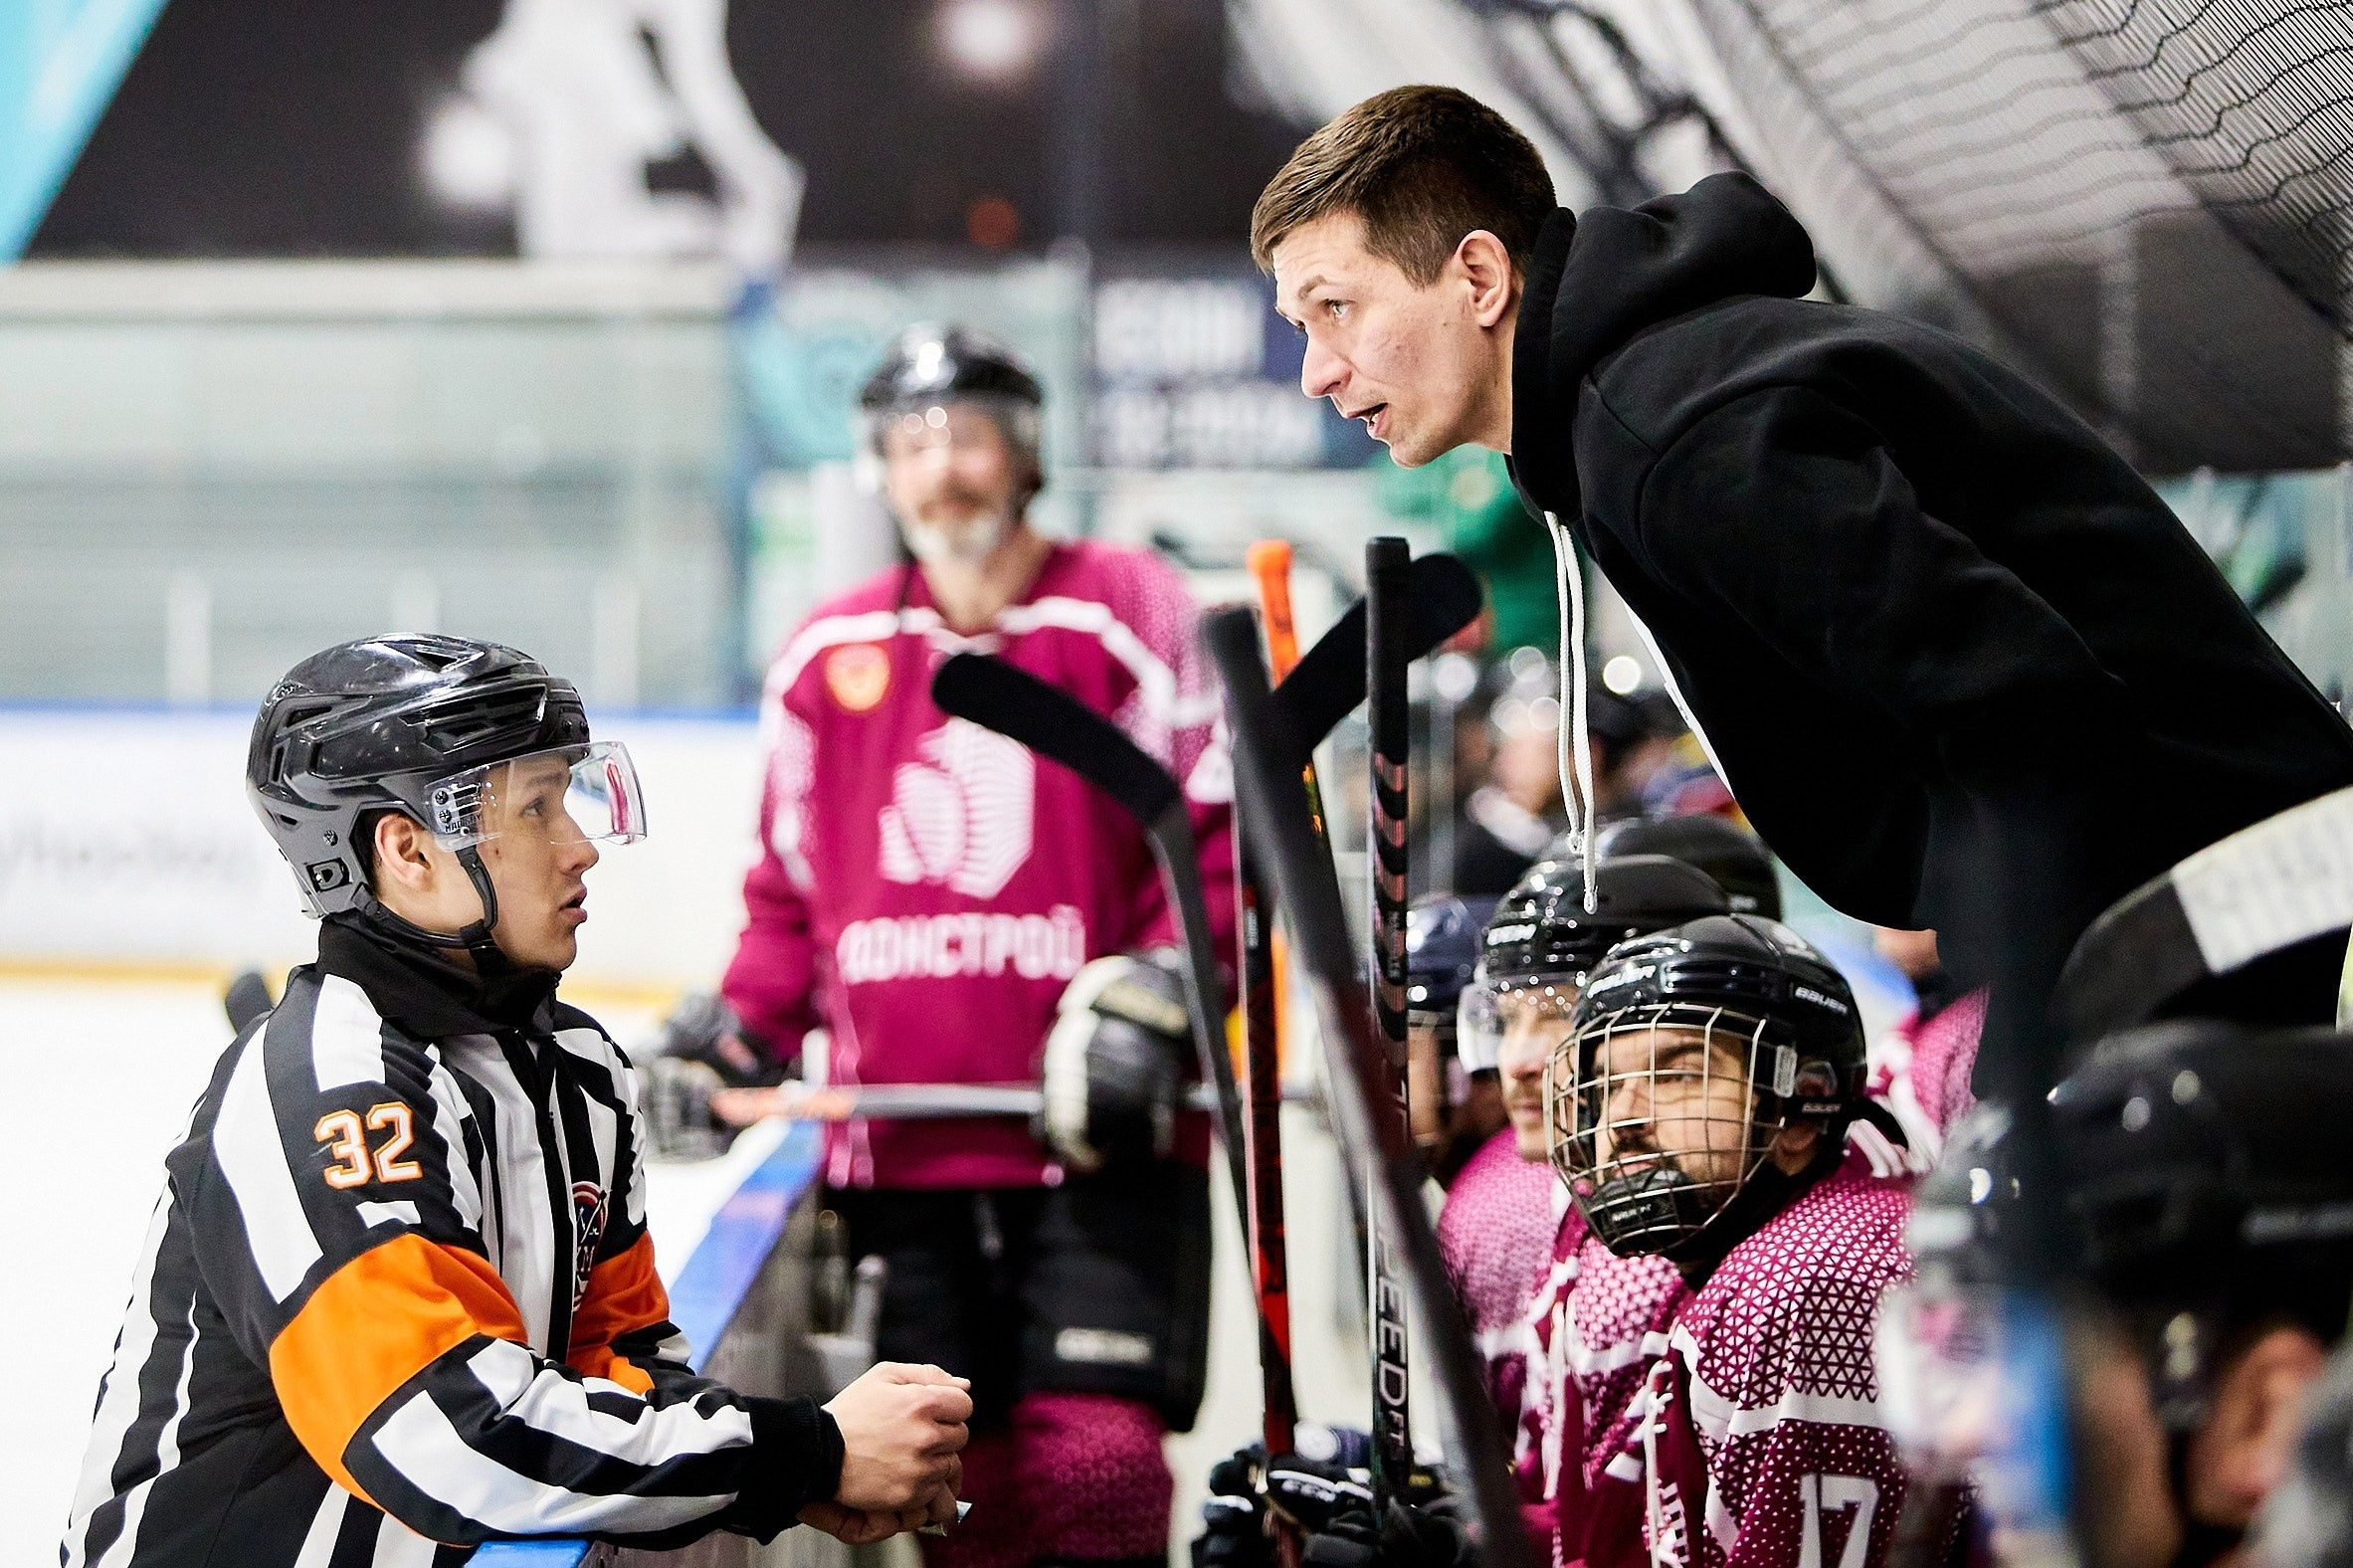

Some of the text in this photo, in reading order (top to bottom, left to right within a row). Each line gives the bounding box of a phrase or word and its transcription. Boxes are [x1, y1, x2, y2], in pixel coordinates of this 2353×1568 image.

[1795, 986, 1849, 1014] BAUER
[313, 1100, 424, 1191] 32
[1799, 1472, 1879, 1568] 17
